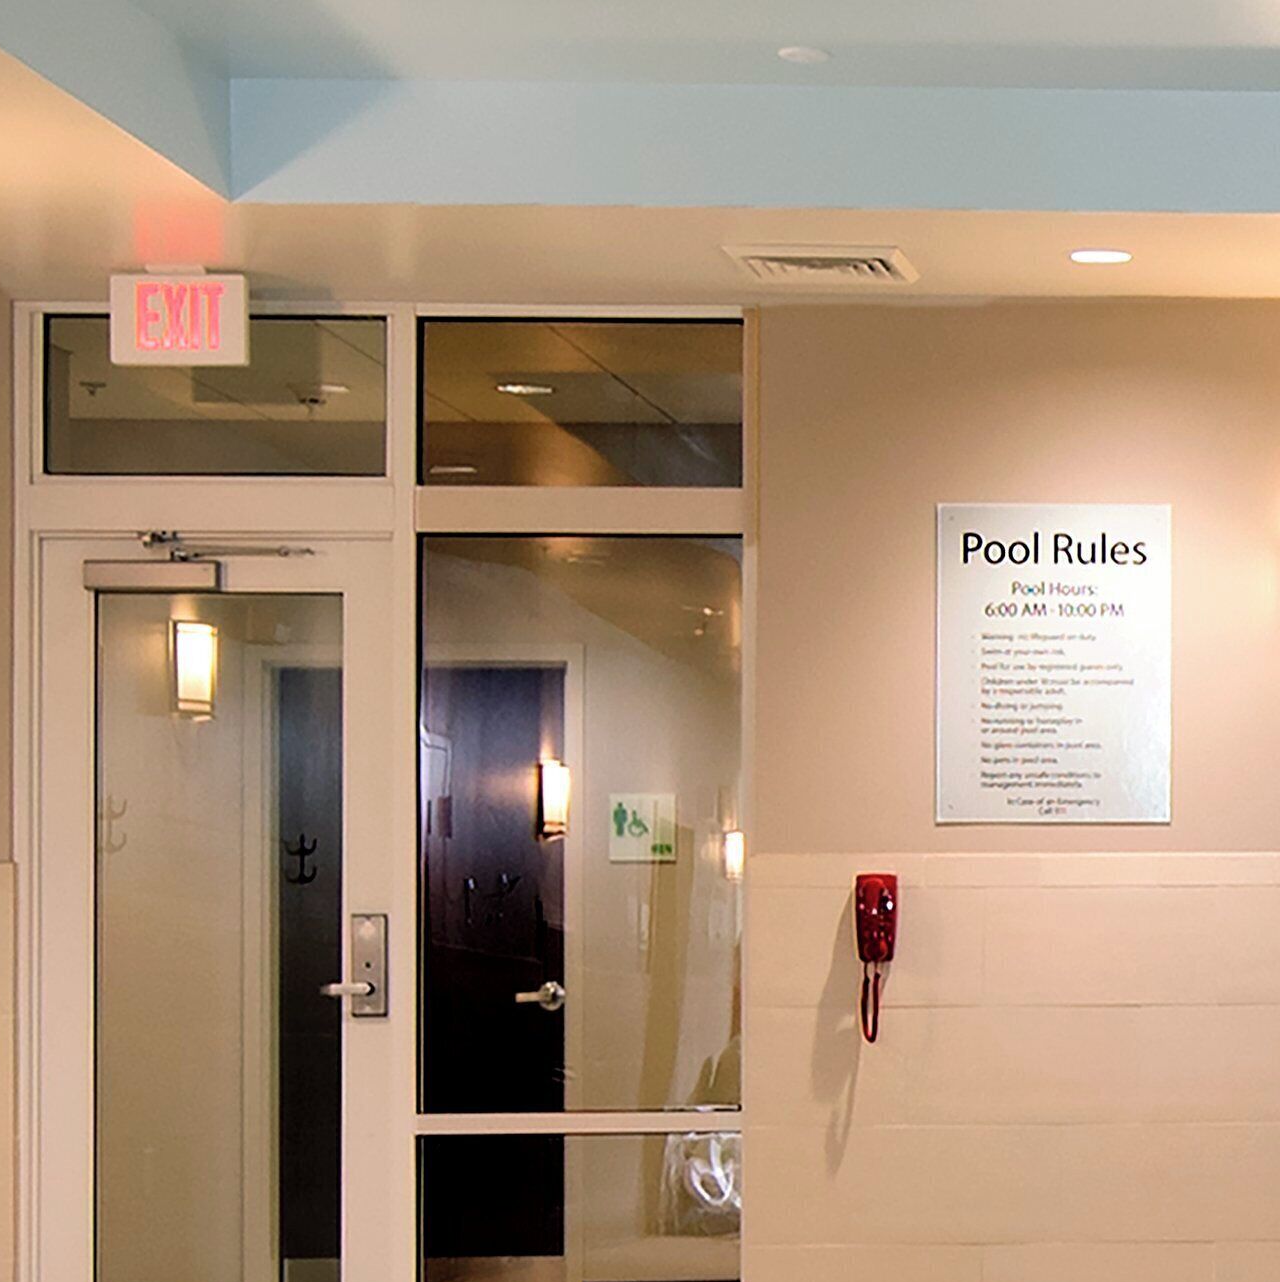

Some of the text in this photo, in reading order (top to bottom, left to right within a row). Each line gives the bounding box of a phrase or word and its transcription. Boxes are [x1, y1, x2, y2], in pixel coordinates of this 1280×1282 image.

[136, 282, 224, 350] EXIT
[963, 532, 1147, 565] Pool Rules
[1012, 581, 1045, 596] Pool
[985, 603, 1018, 617] 6:00
[1021, 603, 1047, 617] AM
[1100, 603, 1125, 617] PM
